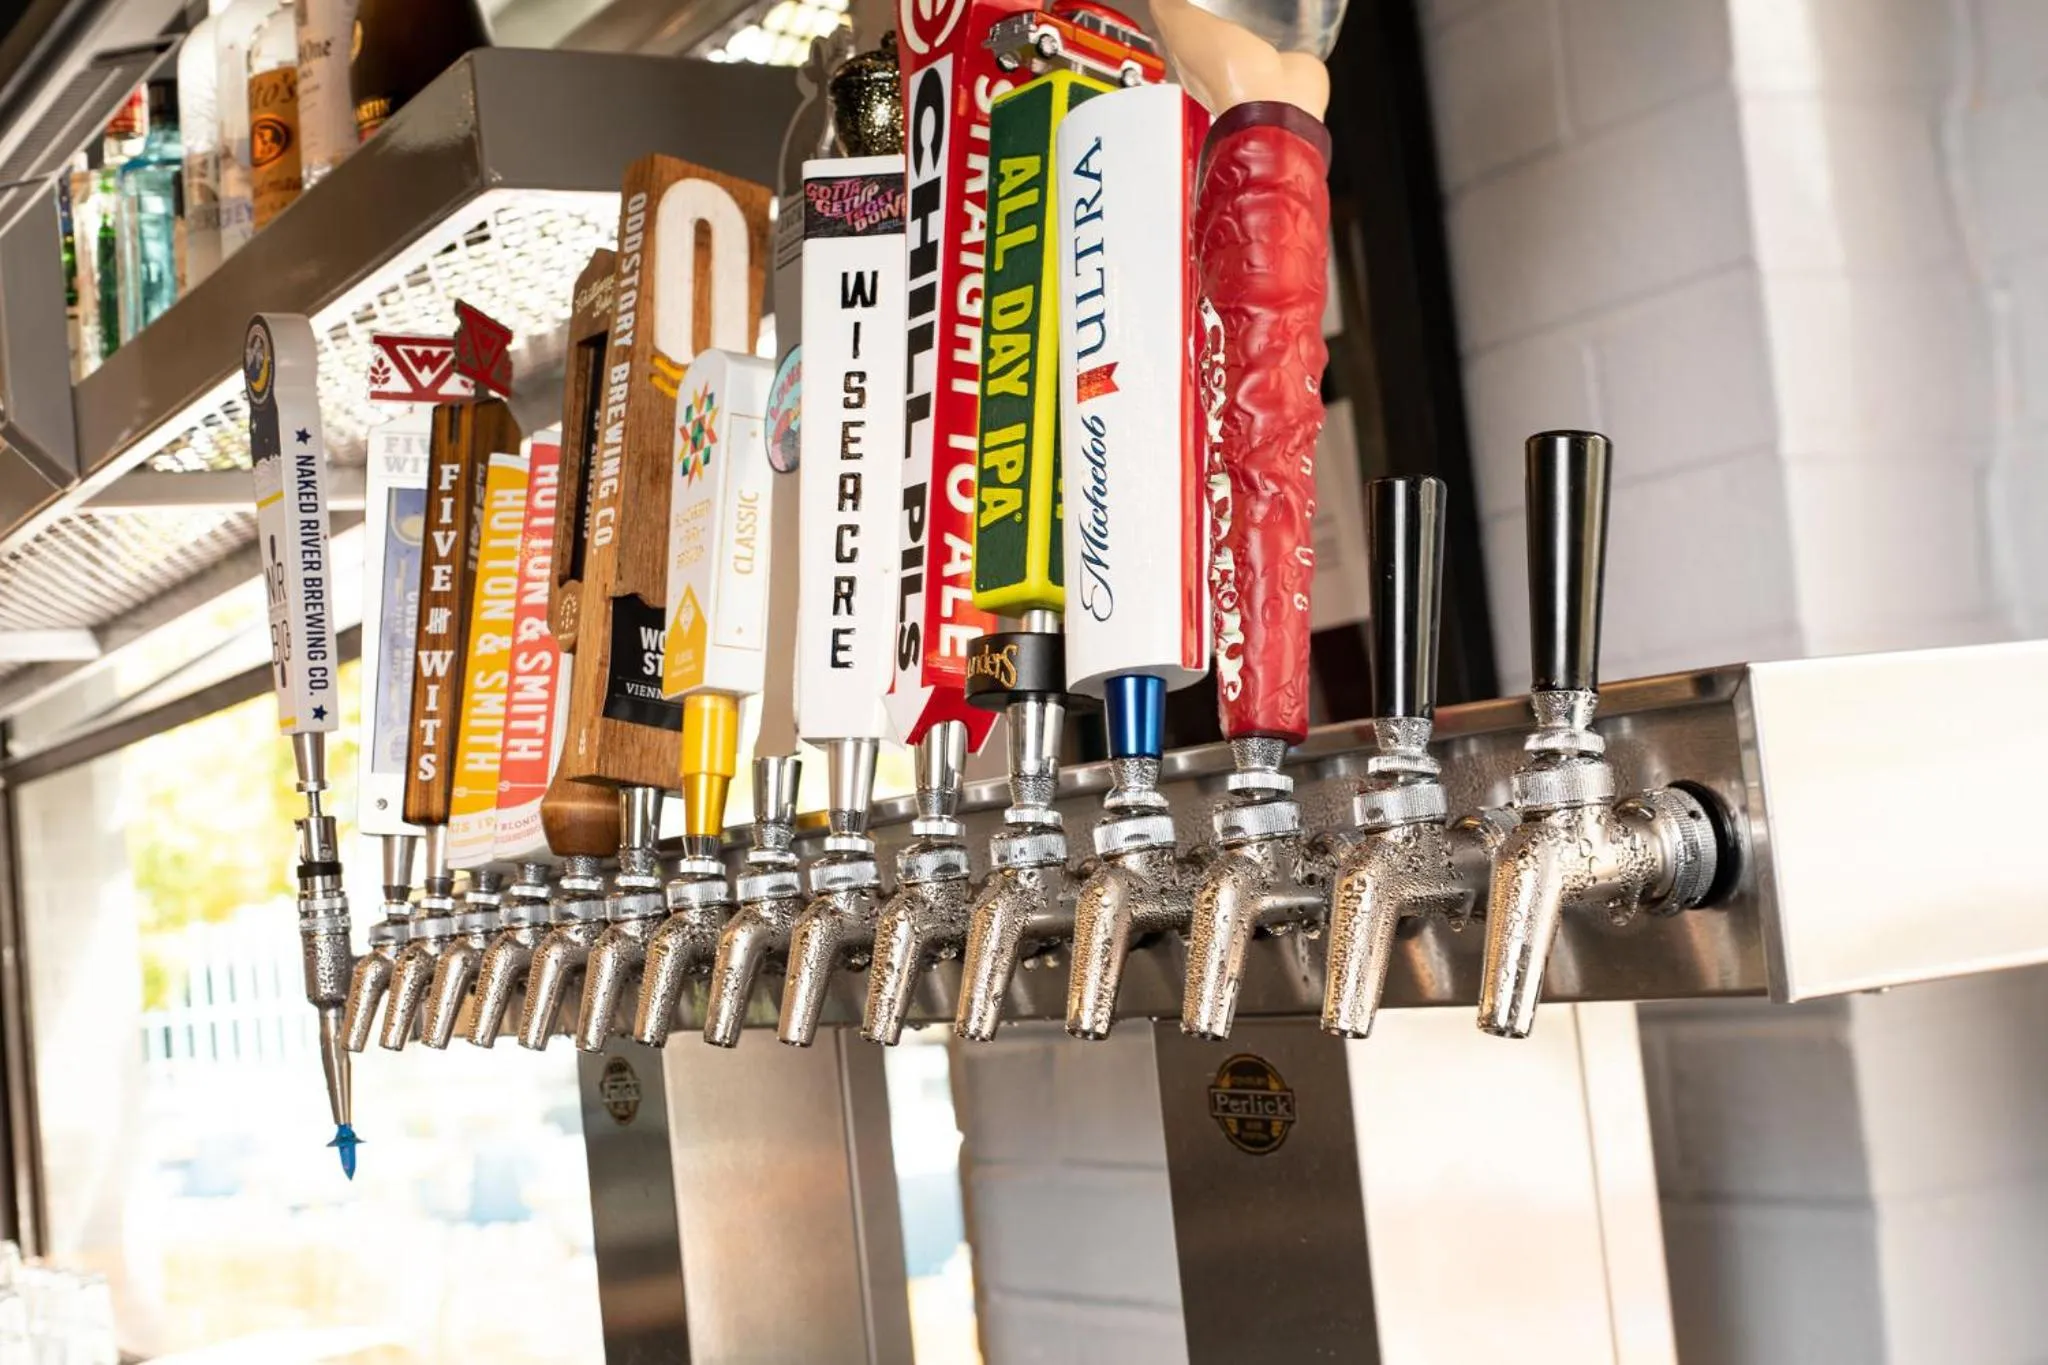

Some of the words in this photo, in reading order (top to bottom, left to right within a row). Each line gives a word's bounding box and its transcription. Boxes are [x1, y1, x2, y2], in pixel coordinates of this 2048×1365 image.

[806, 177, 863, 202] GOTTA
[951, 74, 1015, 396] STRAIGHT
[993, 154, 1042, 273] ALL
[613, 191, 648, 347] ODDSTORY
[904, 67, 945, 460] CHILL
[1073, 136, 1106, 373] ULTRA
[986, 283, 1035, 398] DAY
[599, 361, 631, 500] BREWING
[830, 269, 878, 669] WISEACRE
[945, 433, 978, 514] TO
[296, 455, 319, 514] NAKED
[430, 463, 461, 592] FIVE
[592, 506, 616, 555] CO.
[732, 489, 760, 575] CLASSIC
[1078, 414, 1114, 623] Michelob
[300, 519, 323, 571] RIVER
[480, 488, 527, 621] HUTTON
[897, 482, 927, 672] PILS
[939, 532, 984, 658] ALE
[303, 577, 328, 661] BREWING
[475, 632, 512, 656] &
[516, 617, 550, 645] &
[639, 626, 666, 651] WO
[642, 652, 665, 677] ST
[307, 666, 329, 696] CO.
[417, 650, 454, 782] WITS
[464, 670, 509, 772] SMITH
[506, 650, 553, 760] SMITH
[625, 681, 665, 700] VIENN
[501, 813, 538, 831] BLOND
[1215, 1093, 1291, 1116] Perlick
